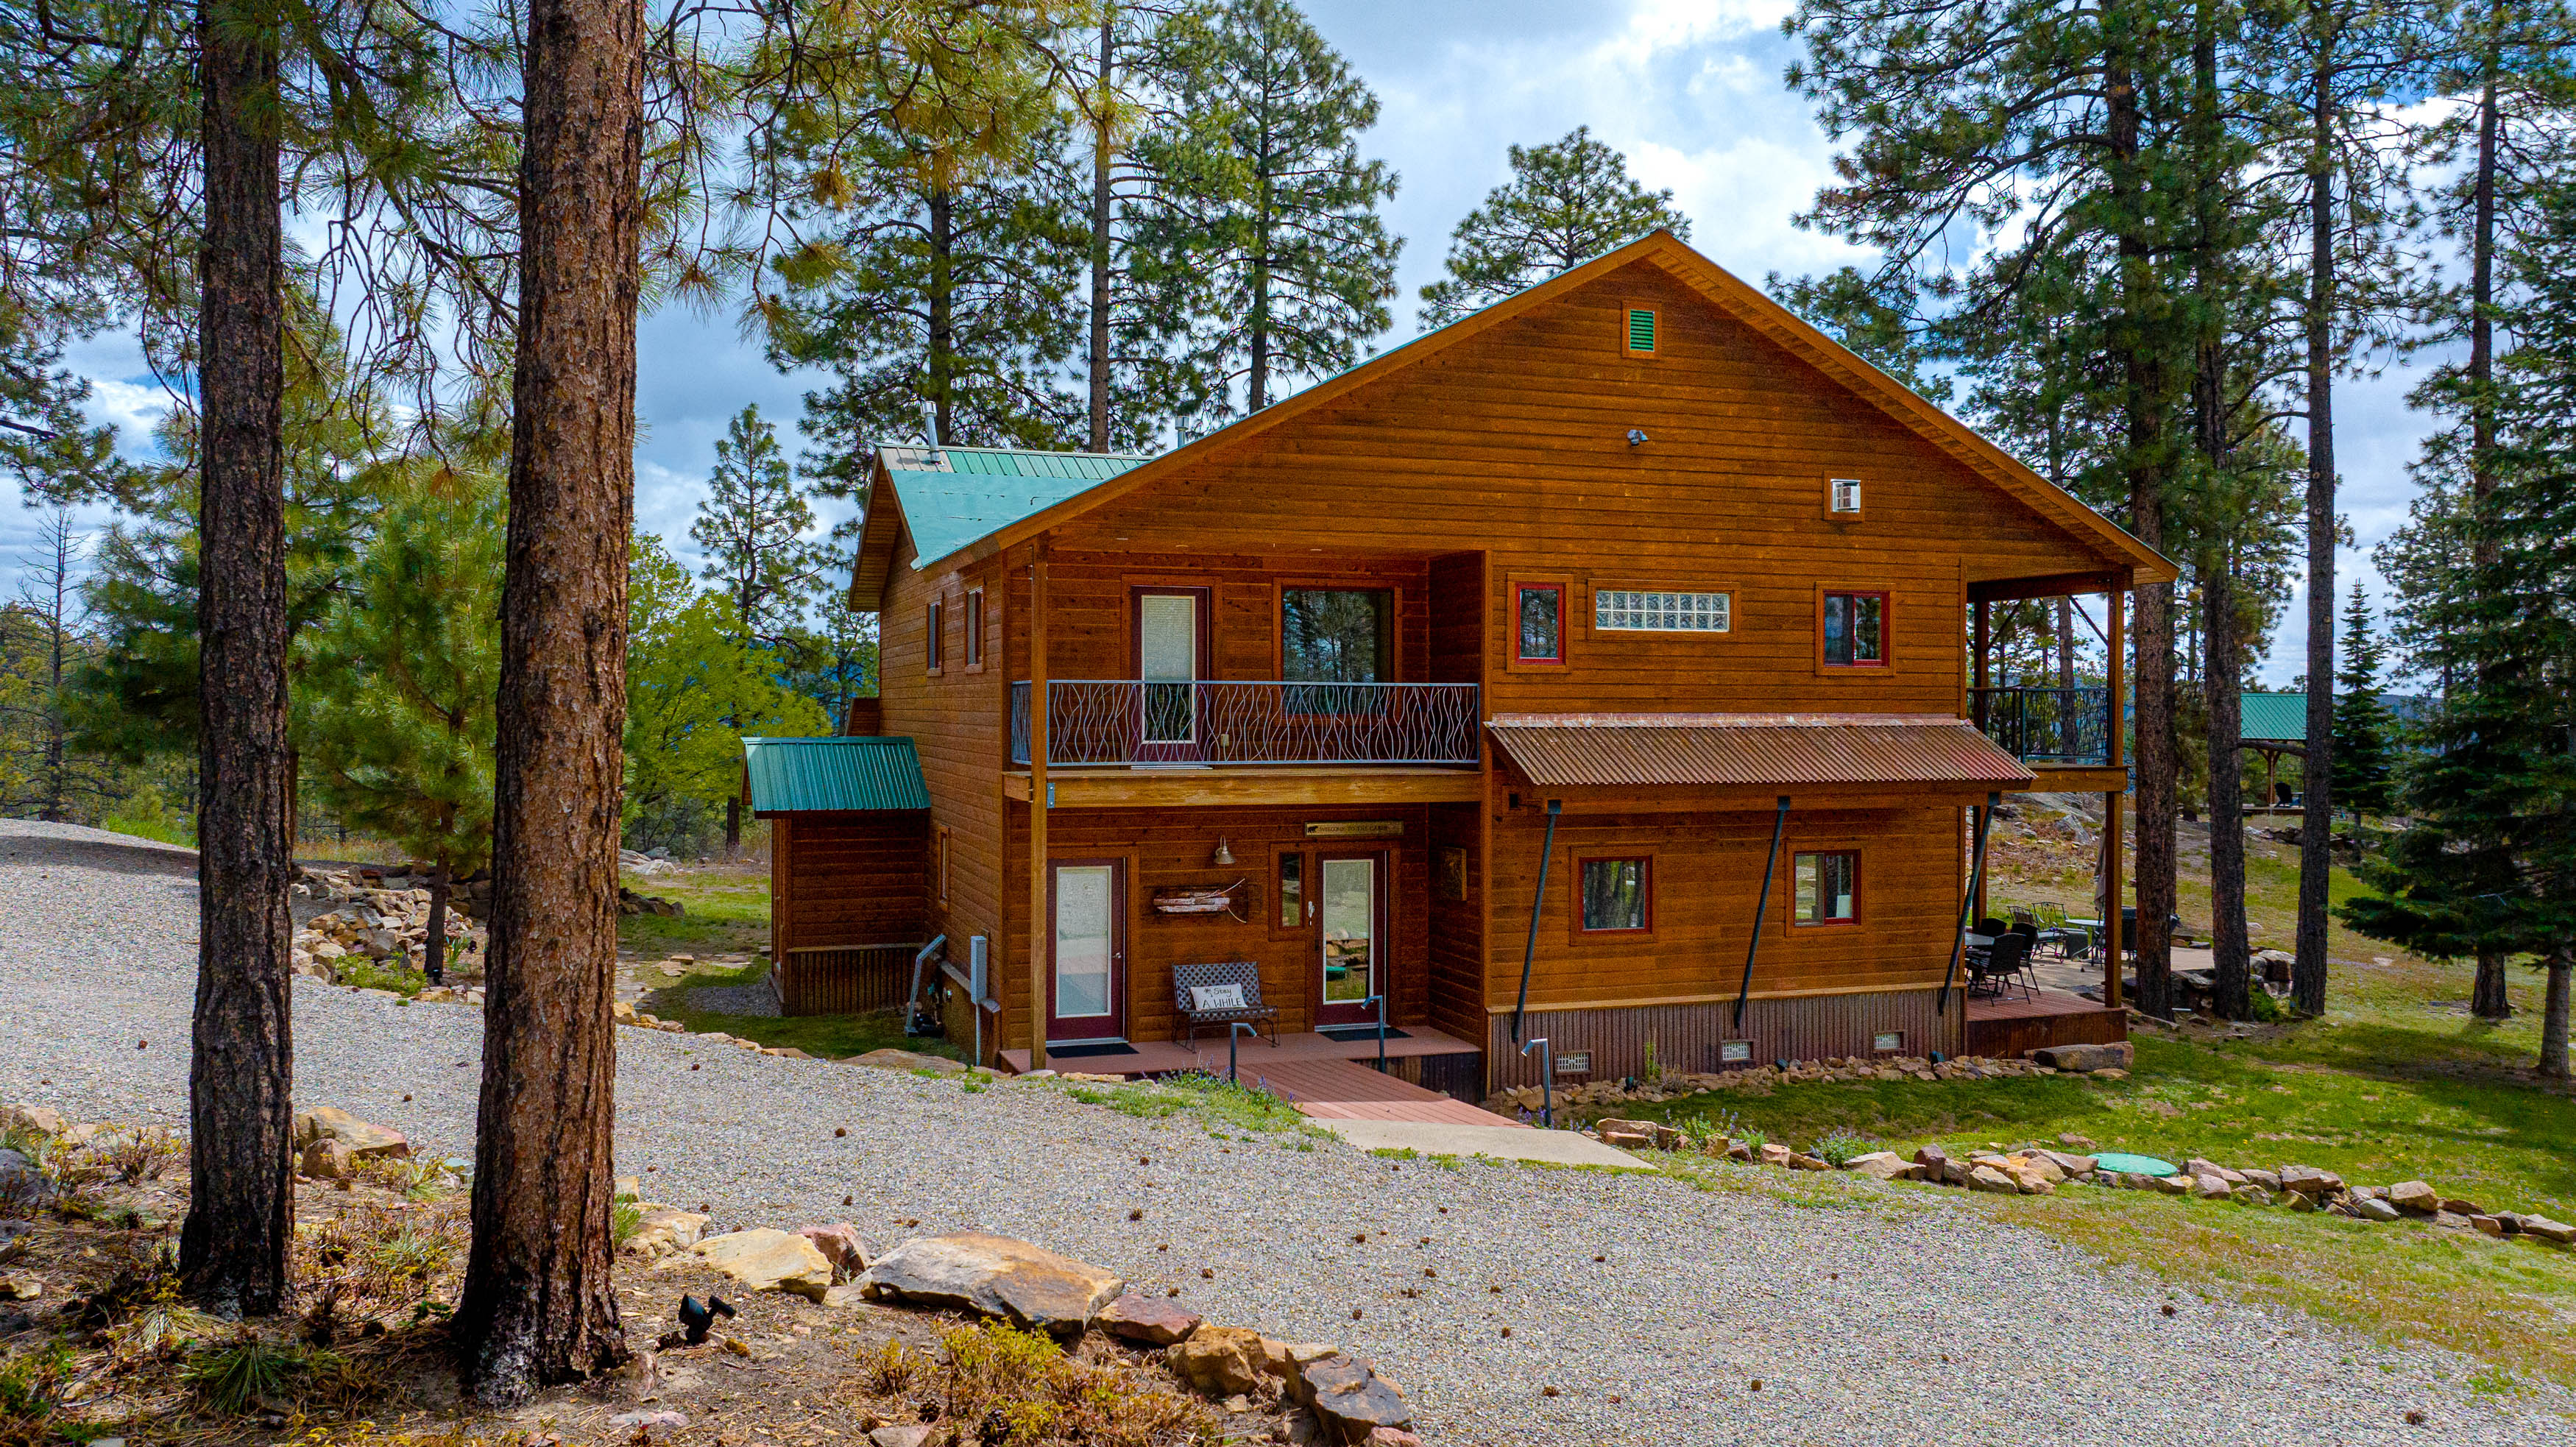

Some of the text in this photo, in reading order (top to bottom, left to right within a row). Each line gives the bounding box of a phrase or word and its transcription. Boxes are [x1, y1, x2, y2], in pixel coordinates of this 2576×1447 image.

[1214, 988, 1232, 997] Stay
[1203, 997, 1242, 1008] A WHILE
